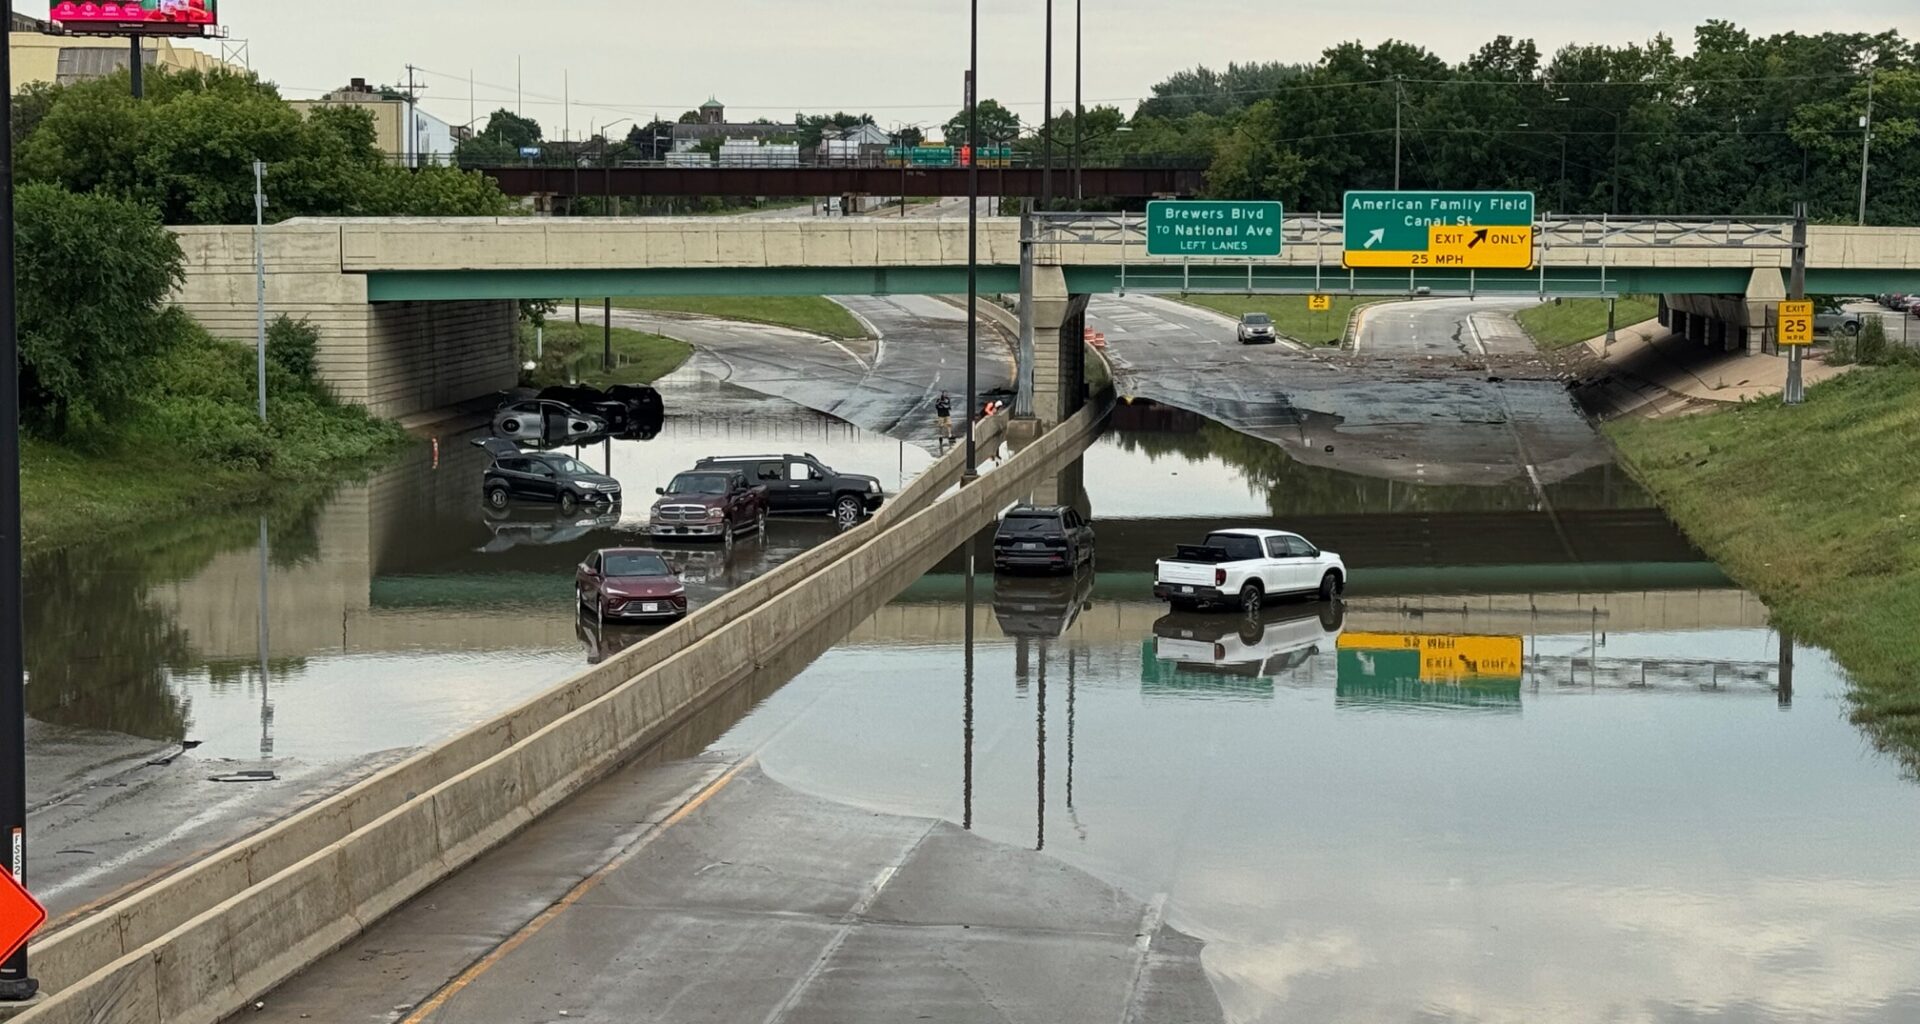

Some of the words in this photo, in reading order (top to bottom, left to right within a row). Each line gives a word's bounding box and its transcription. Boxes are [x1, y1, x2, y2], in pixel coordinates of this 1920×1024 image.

[1352, 198, 1423, 210] American
[1430, 198, 1482, 213] Family
[1490, 198, 1527, 210] Field
[1165, 208, 1224, 219] Brewers
[1231, 208, 1264, 219] Blvd
[1404, 215, 1447, 227] Canal
[1456, 215, 1473, 227] St
[1156, 225, 1170, 235] TO
[1175, 224, 1238, 236] National
[1246, 224, 1273, 236] Ave
[1435, 234, 1464, 244] EXIT
[1491, 234, 1527, 244] ONLY
[1180, 241, 1206, 250] LEFT
[1212, 241, 1248, 250] LANES
[1411, 254, 1429, 264] 25
[1435, 254, 1464, 264] MPH
[1785, 305, 1806, 313] EXIT
[1784, 319, 1807, 333] 25
